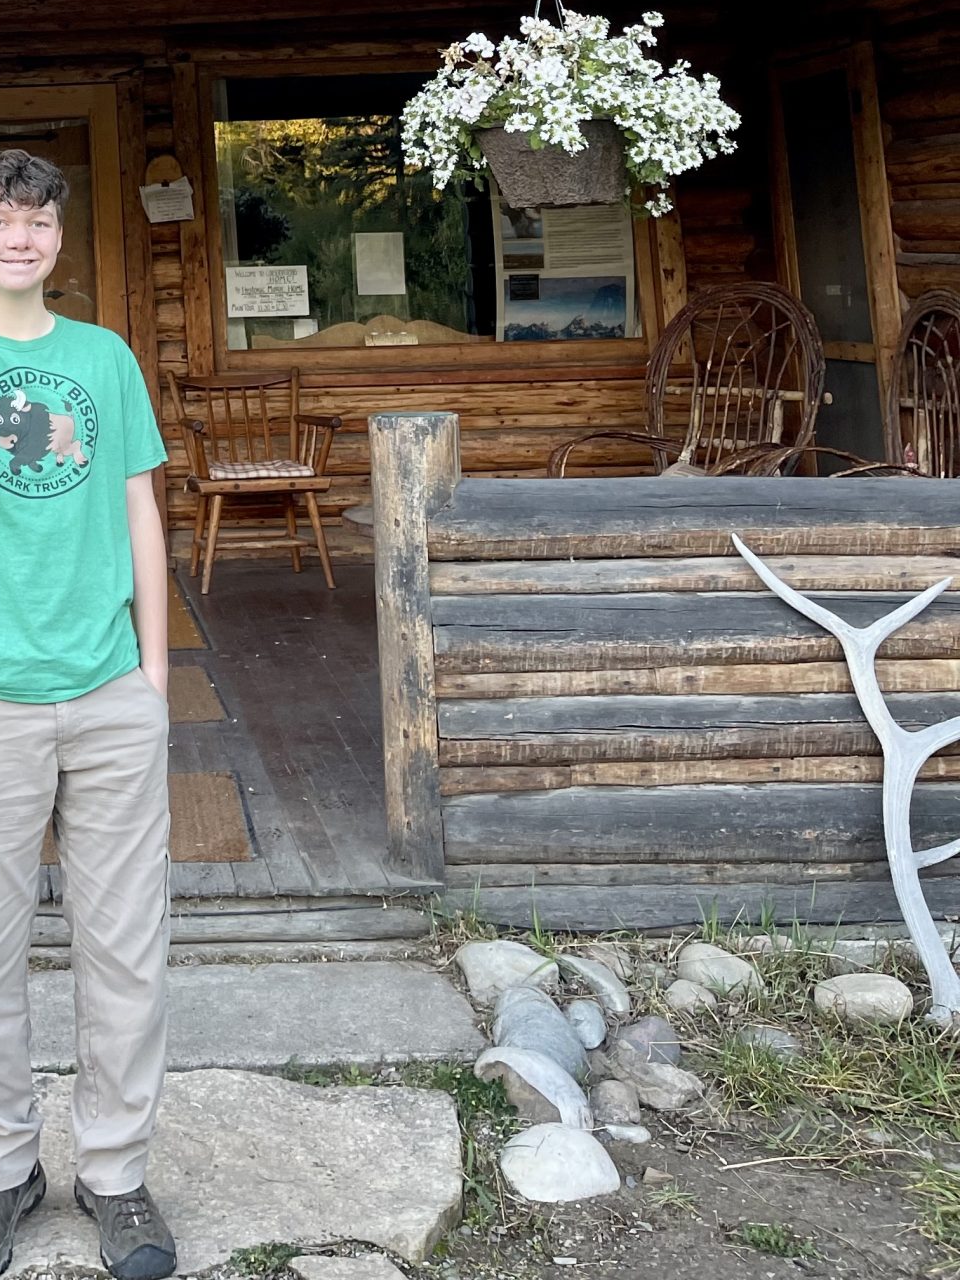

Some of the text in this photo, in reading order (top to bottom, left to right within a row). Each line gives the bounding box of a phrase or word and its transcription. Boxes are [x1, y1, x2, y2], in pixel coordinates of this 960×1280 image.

[67, 386, 96, 449] BISON
[0, 471, 30, 493] PARK
[34, 474, 73, 493] TRUST
